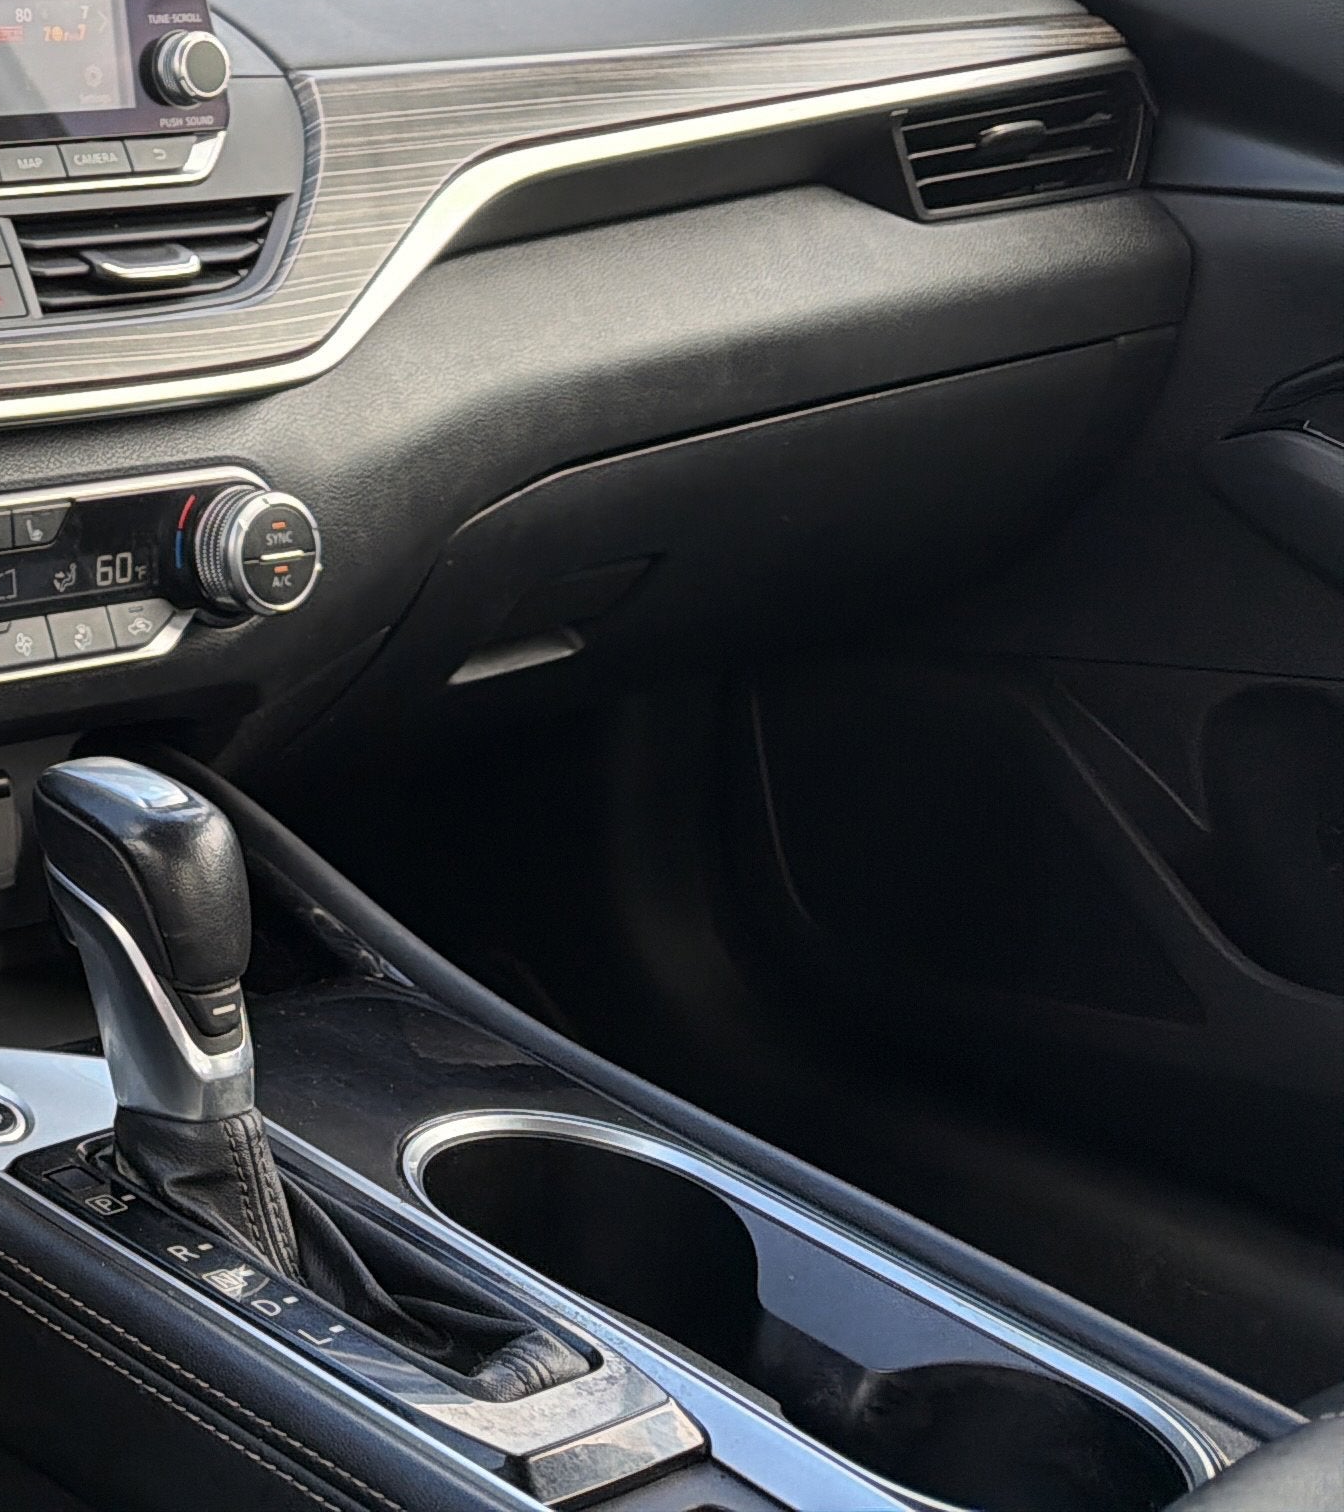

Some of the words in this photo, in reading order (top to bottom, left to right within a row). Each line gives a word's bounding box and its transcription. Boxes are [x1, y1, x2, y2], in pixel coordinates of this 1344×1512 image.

[15, 7, 32, 24] 80
[159, 117, 183, 128] PUSH
[185, 115, 214, 126] SOUND
[17, 156, 43, 171] MAP
[73, 151, 118, 167] CAMERA
[266, 530, 294, 546] SYNC
[272, 574, 294, 589] A/C
[98, 1196, 119, 1214] P
[167, 1244, 200, 1262] R
[251, 1298, 282, 1318] D
[297, 1326, 334, 1346] L
